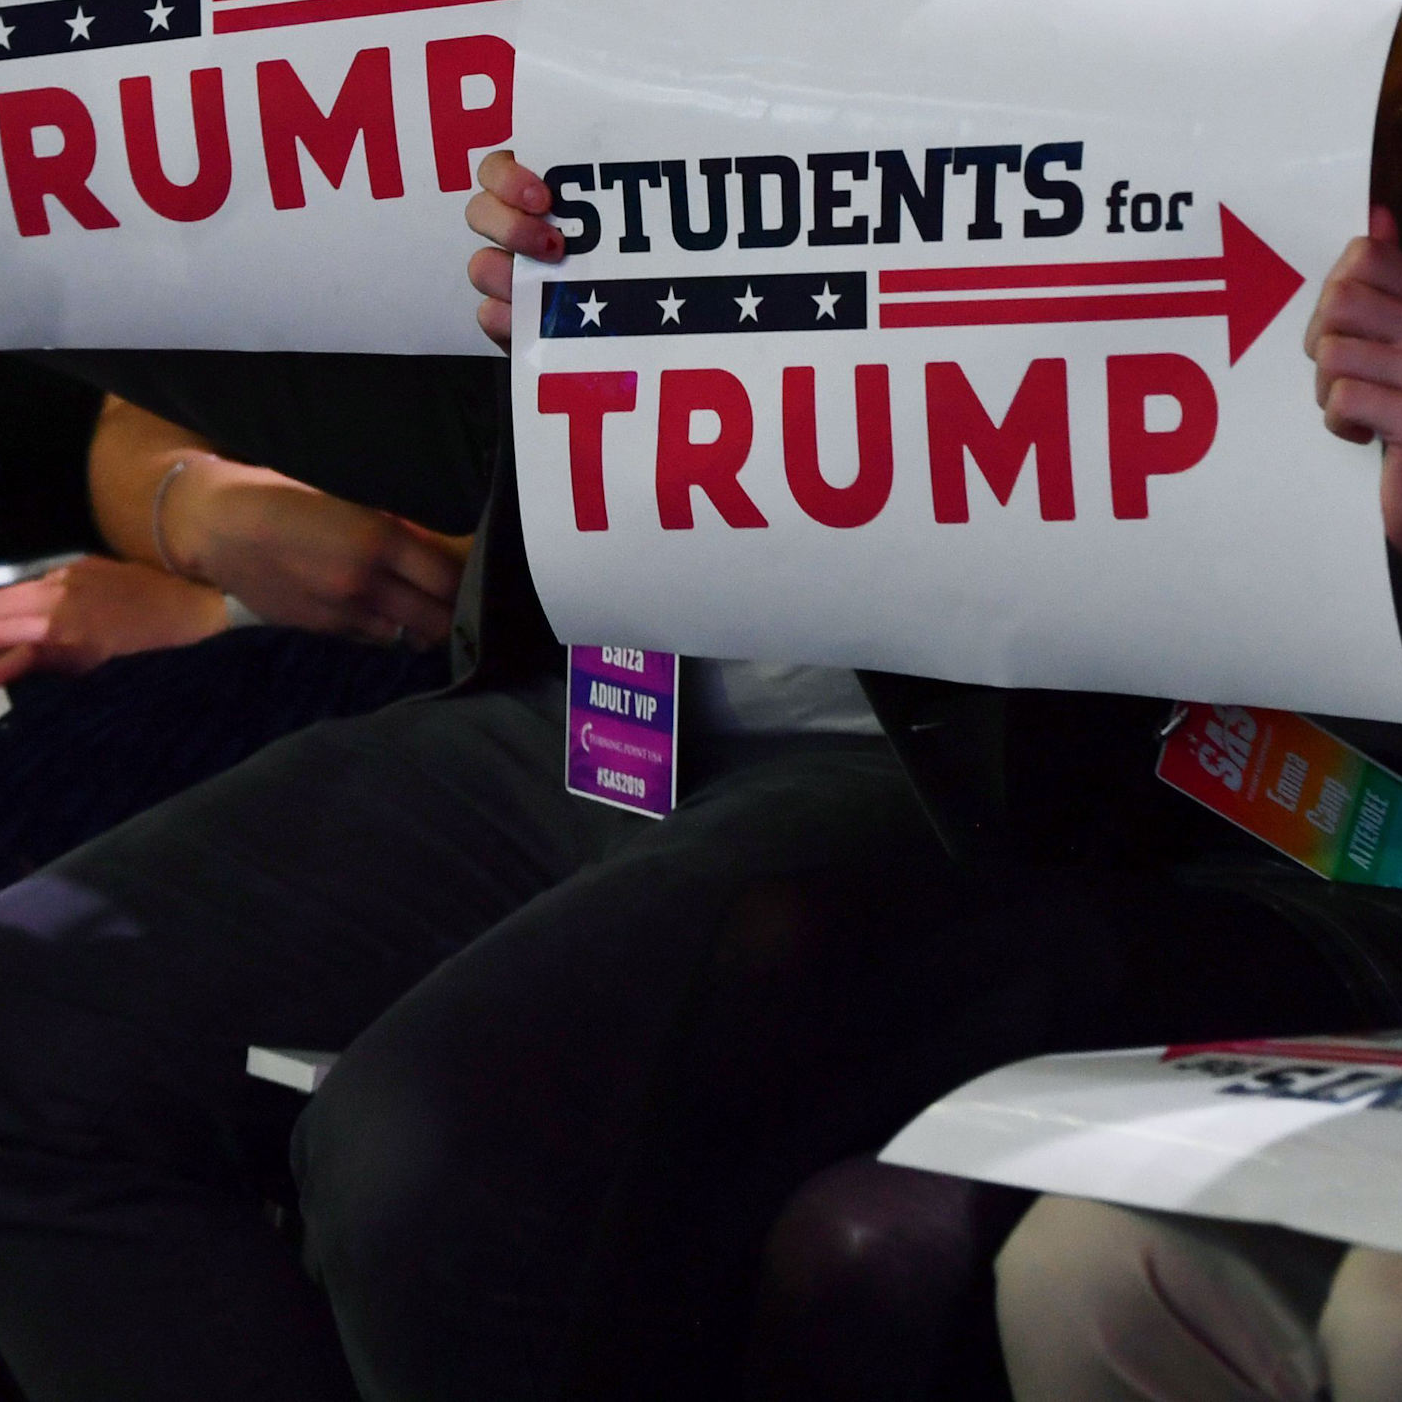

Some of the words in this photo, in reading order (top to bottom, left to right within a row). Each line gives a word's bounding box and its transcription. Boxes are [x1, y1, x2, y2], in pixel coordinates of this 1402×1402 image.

[539, 141, 1085, 256] STUDENTS
[1105, 180, 1194, 234] for
[537, 352, 1220, 533] TRUMP
[588, 680, 632, 716] ADULT
[634, 691, 658, 722] VIP
[1198, 703, 1258, 793] SAS
[1348, 788, 1390, 871] ATTENDEE
